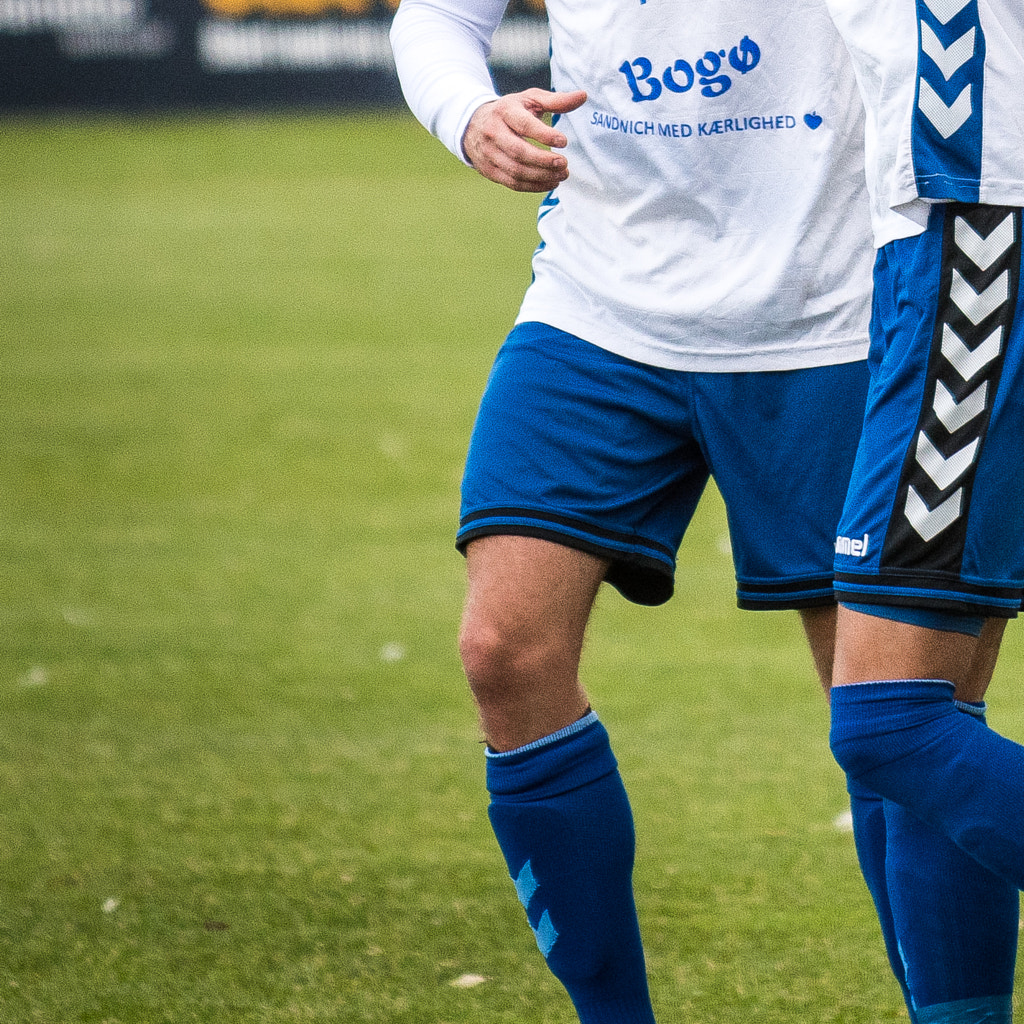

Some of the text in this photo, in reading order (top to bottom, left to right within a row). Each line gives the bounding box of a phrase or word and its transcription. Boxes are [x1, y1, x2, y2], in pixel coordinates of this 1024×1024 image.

[618, 35, 761, 103] Bogø
[658, 122, 693, 138] MED
[698, 115, 796, 137] KÆRLIGHED
